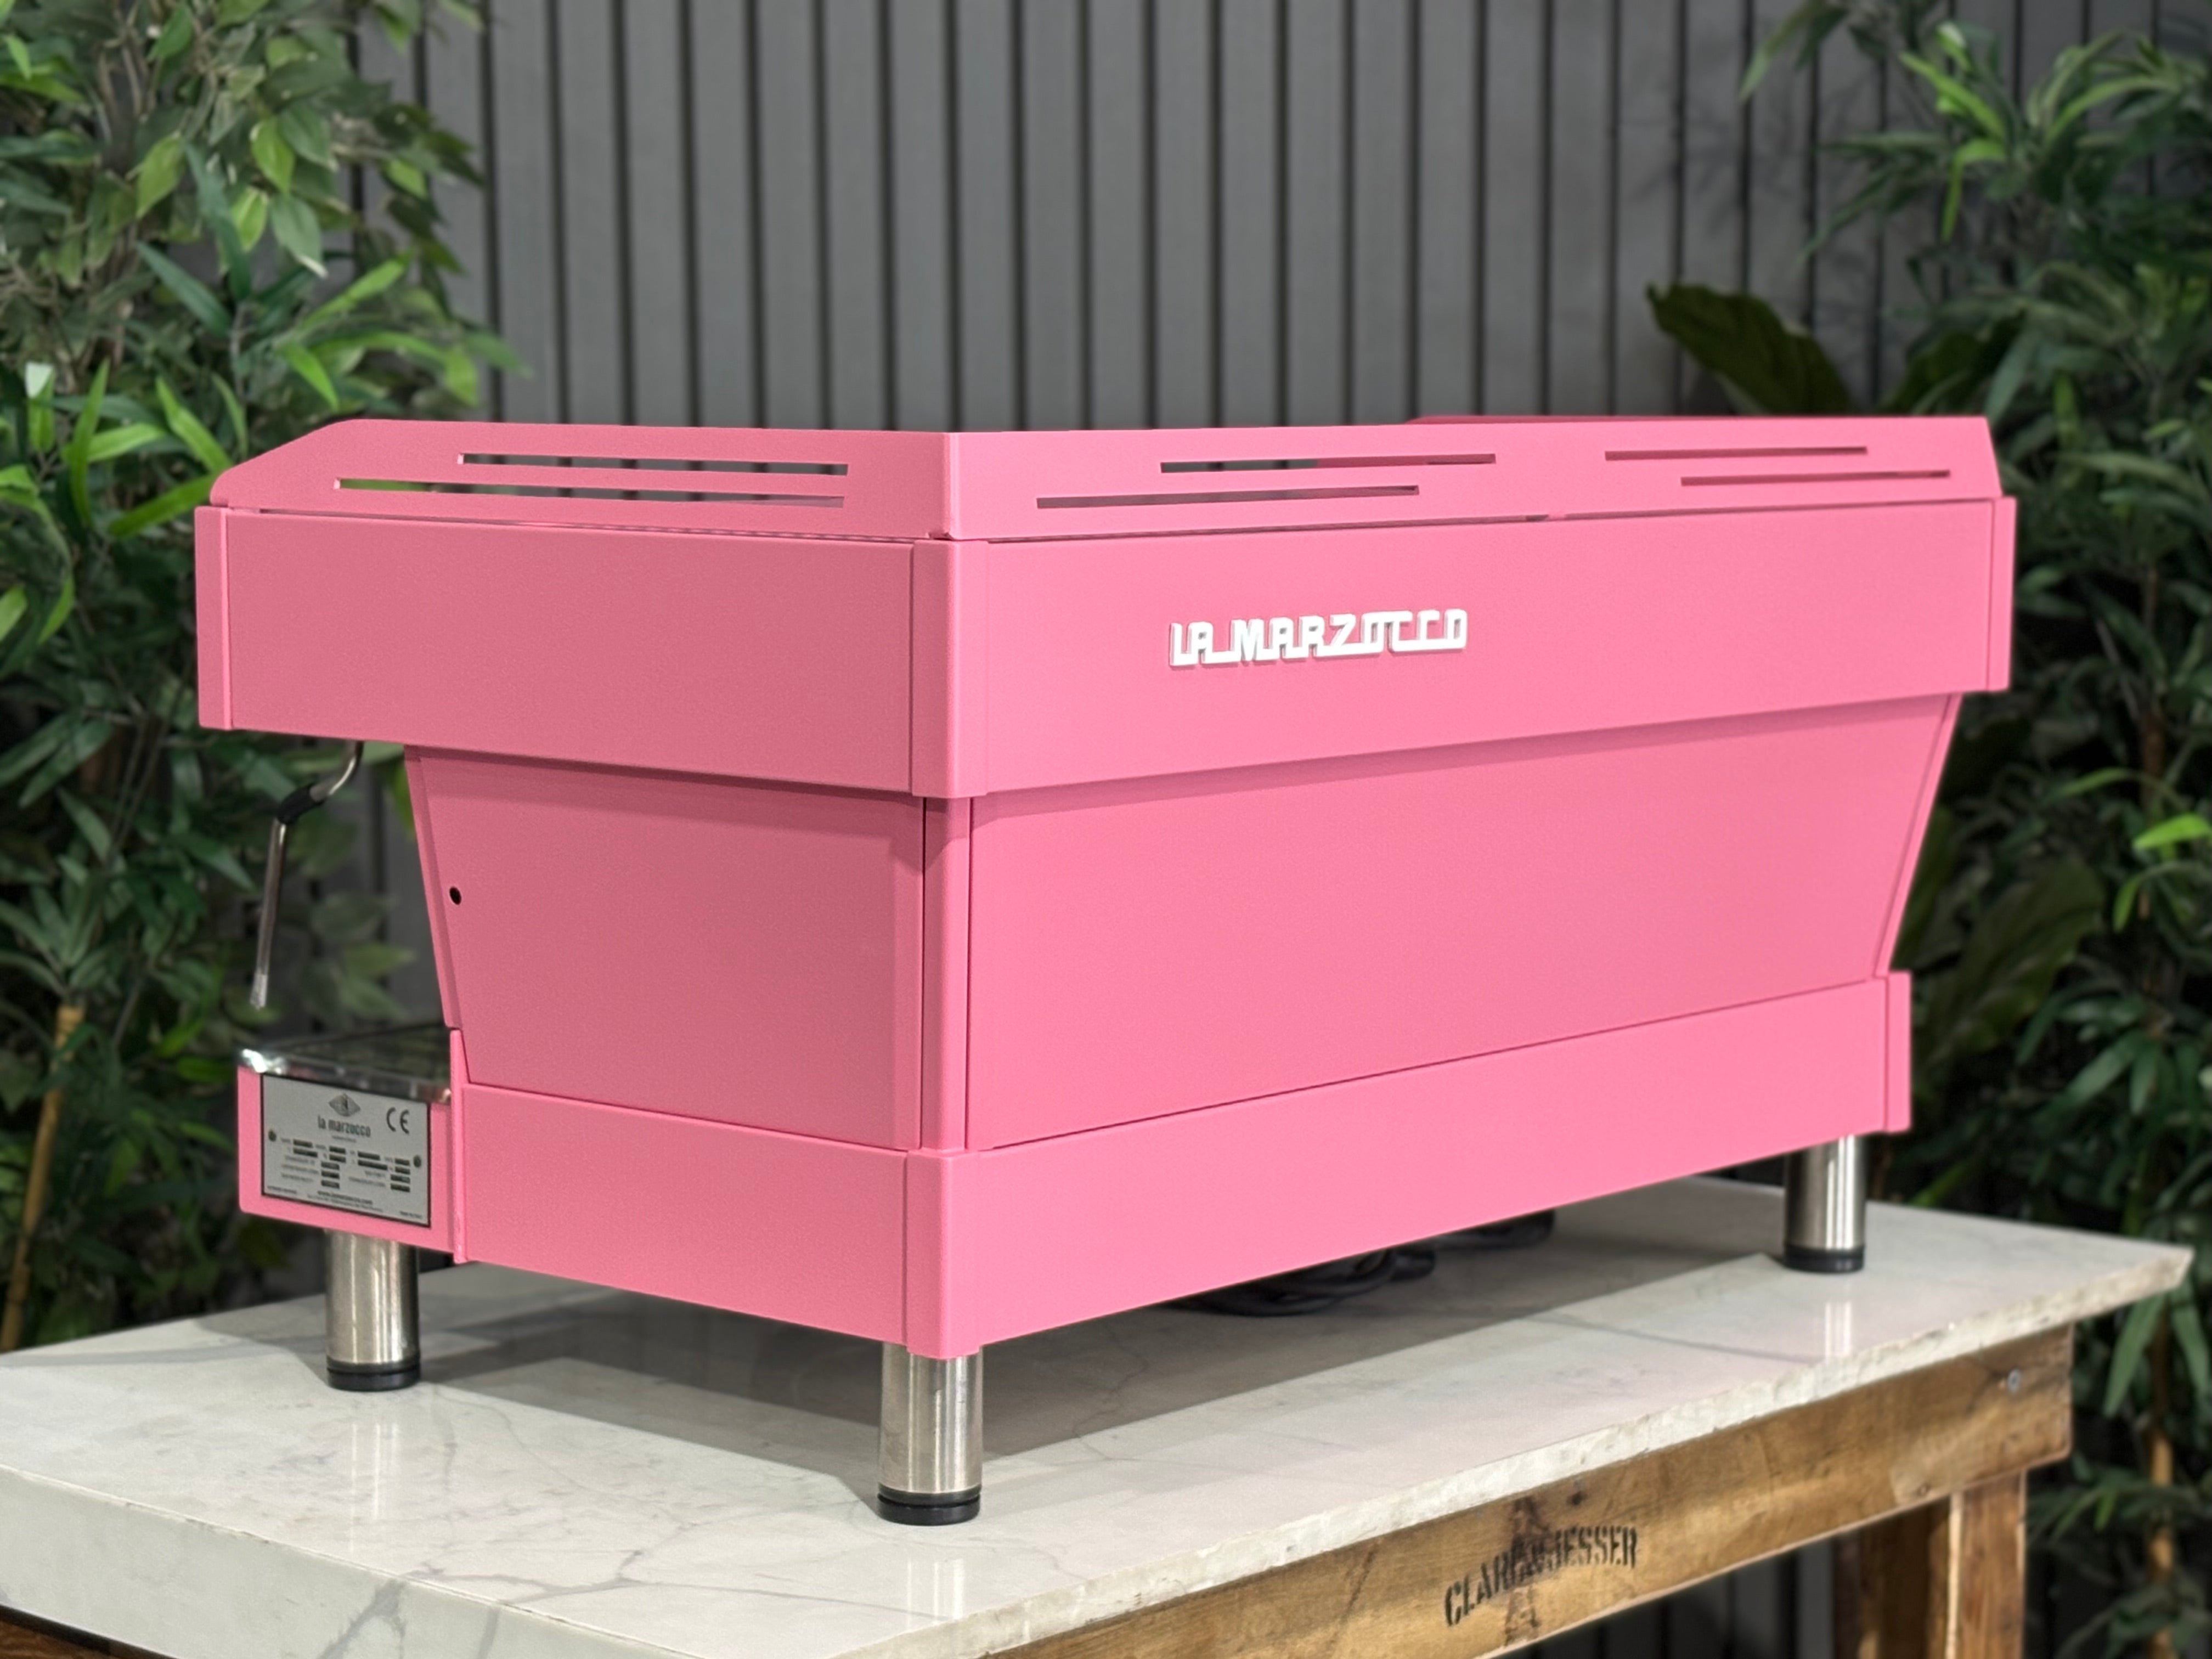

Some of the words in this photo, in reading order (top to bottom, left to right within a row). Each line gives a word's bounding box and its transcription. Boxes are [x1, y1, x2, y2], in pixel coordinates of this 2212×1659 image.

[1169, 622, 1213, 666] LA
[1229, 609, 1468, 665] MARZOCCO
[318, 1114, 326, 1130] la
[328, 1119, 371, 1138] marzocco
